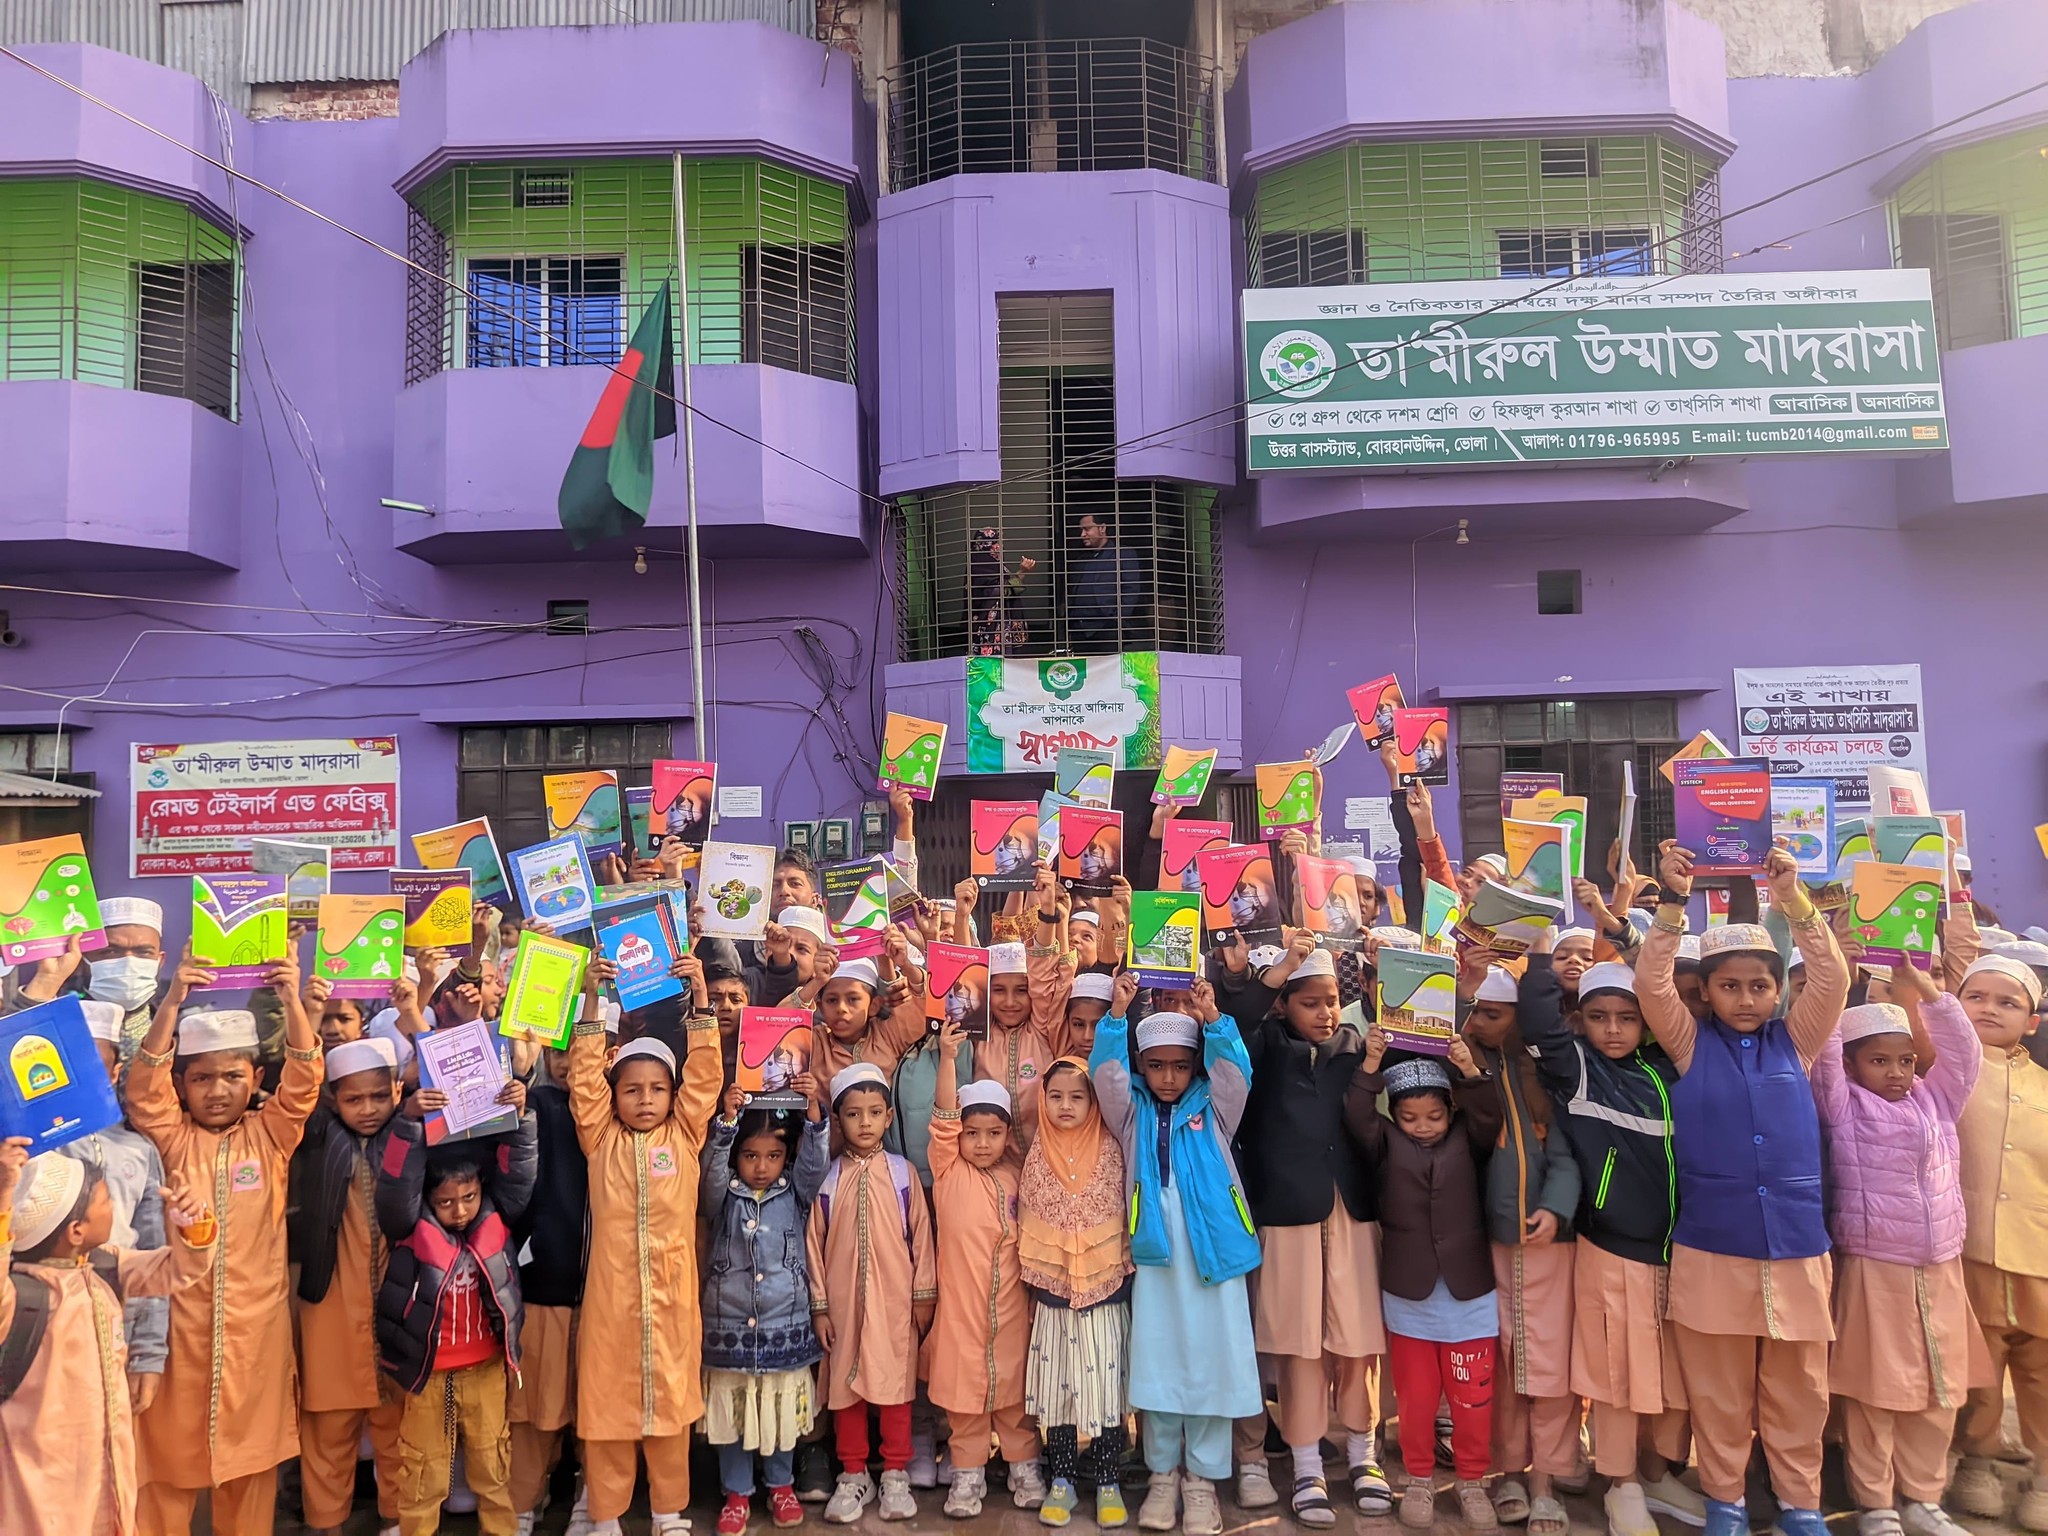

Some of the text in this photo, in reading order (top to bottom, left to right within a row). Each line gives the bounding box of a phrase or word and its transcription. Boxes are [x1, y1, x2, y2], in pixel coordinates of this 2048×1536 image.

[1317, 304, 1357, 315] জ্ঞান
[1366, 304, 1380, 313] ও
[1386, 298, 1483, 312] নৈতিকতার
[1563, 296, 1598, 307] দক্ষ
[1605, 294, 1652, 305] মানব
[1659, 290, 1715, 304] সম্পদ
[1718, 288, 1775, 302] তৈরির
[1783, 286, 1859, 300] অঙ্গীকার
[1572, 317, 1722, 378] উম্মাত
[1289, 411, 1307, 428] প্লে
[1312, 410, 1341, 426] গ্রুপ
[1346, 409, 1382, 425] থেকে
[1386, 408, 1421, 423] দশম
[1426, 402, 1458, 423] শ্রেণি
[1492, 400, 1545, 421] হিফজুল
[1549, 400, 1600, 421] কুরআন
[1604, 400, 1637, 415] শাখা
[1728, 395, 1761, 412] শাখা
[1773, 393, 1848, 412] আবাসিক
[1861, 391, 1934, 410] অনাবাসিক
[1268, 440, 1296, 458] উত্তর
[1366, 434, 1449, 455] বোরহানউদ্দিন,
[1568, 432, 1680, 448] 01796-965995
[1692, 430, 1742, 444] E-mail:
[1746, 426, 1908, 443] tucmb2014@gmail.com
[1766, 688, 1891, 705] এই শাখায়
[1048, 702, 1081, 714] উম্মাহর
[1085, 701, 1124, 714] আঙ্গিনায়
[1042, 716, 1085, 726] আপনাকে
[1808, 708, 1834, 731] উম্মাত
[1747, 735, 1885, 757] ভর্তি কার্যক্রম চলছে
[246, 752, 294, 772] উম্মাত
[1776, 763, 1799, 772] নেসাব
[149, 798, 200, 817] রেমন্ড
[207, 789, 279, 817] টেইলার্স
[283, 795, 316, 813] এন্ড
[201, 825, 222, 833] থেকে
[845, 865, 872, 875] GRAMMAR
[826, 880, 860, 889] COMPOSITION
[1450, 1351, 1475, 1366] DO IT
[1451, 1365, 1470, 1381] YOU
